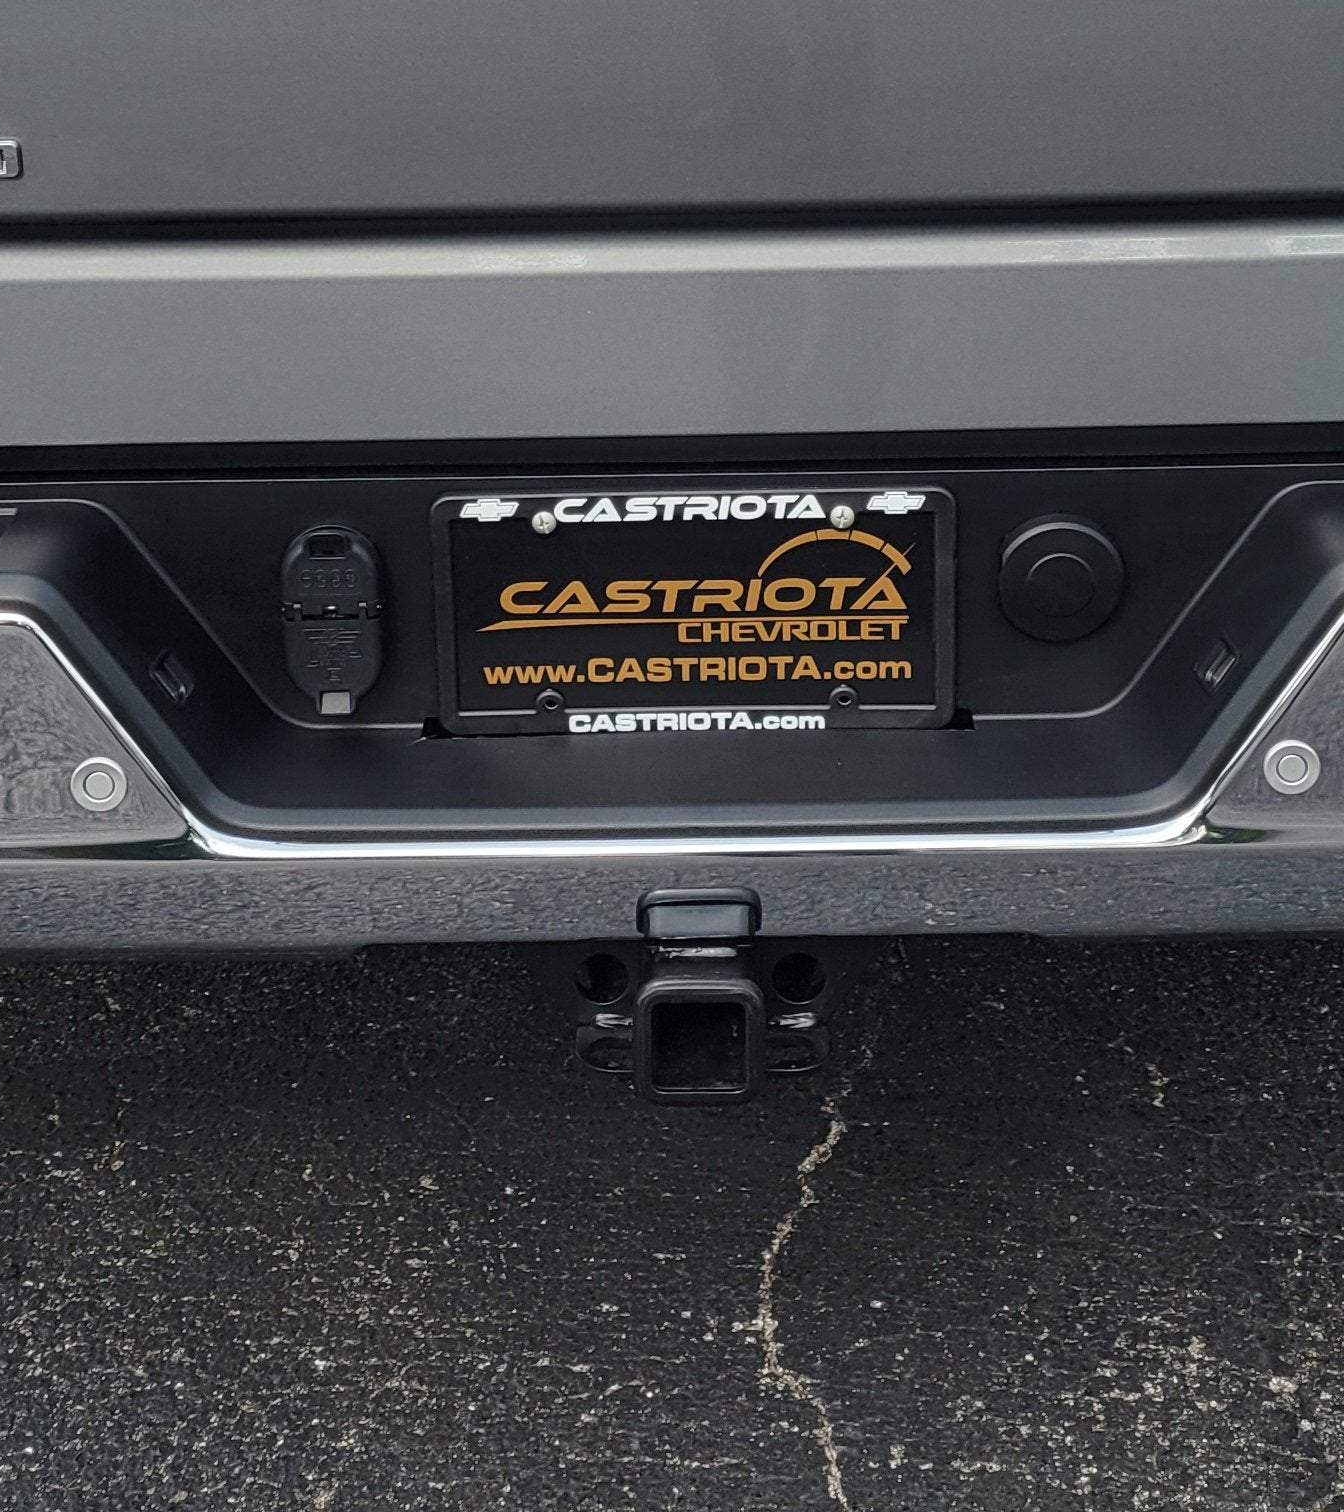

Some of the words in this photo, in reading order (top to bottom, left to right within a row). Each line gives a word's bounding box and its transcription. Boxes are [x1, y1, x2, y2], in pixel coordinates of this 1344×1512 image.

[554, 495, 826, 523] CASTRIOTA
[500, 577, 907, 614] CASTRIOTA
[677, 619, 908, 643] CHEVROLET
[483, 656, 912, 685] www.CASTRIOTA.com
[568, 711, 826, 734] CASTRIOTA.com
